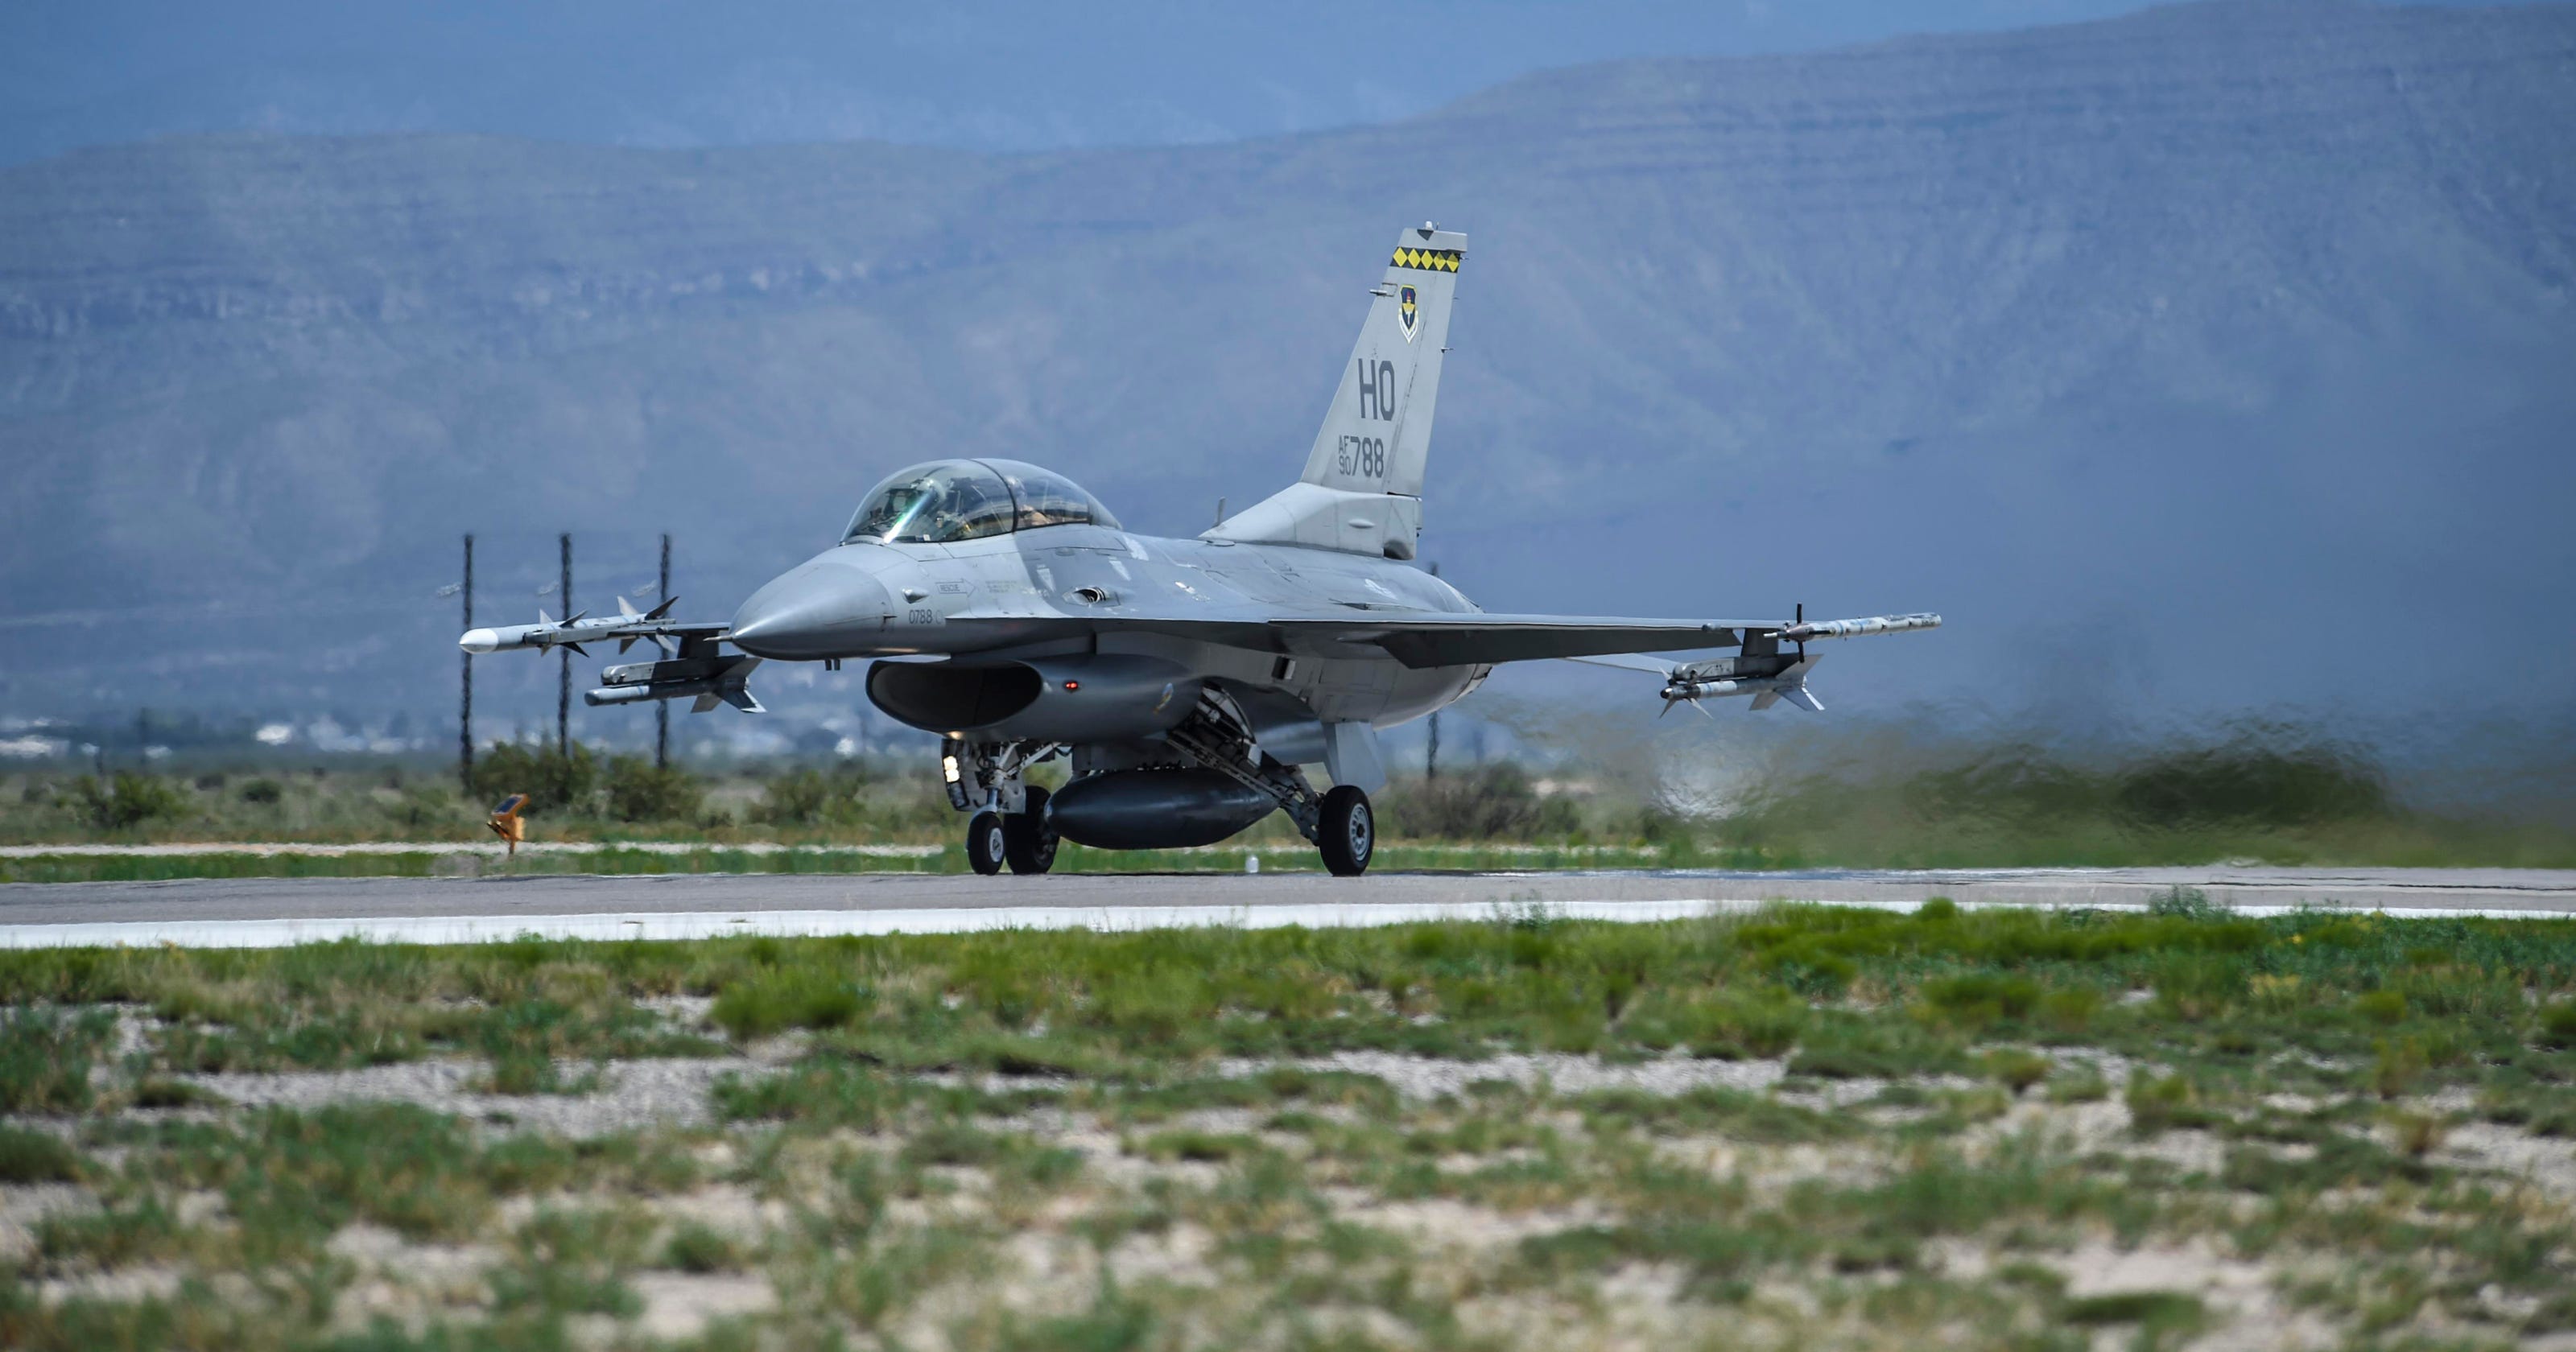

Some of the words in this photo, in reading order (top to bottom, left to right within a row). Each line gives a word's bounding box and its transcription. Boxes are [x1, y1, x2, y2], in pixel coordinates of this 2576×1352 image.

[1358, 358, 1395, 422] HO
[1339, 435, 1350, 455] AF
[1339, 455, 1351, 476] 90
[1350, 435, 1384, 478] 788
[908, 609, 933, 624] 0788
